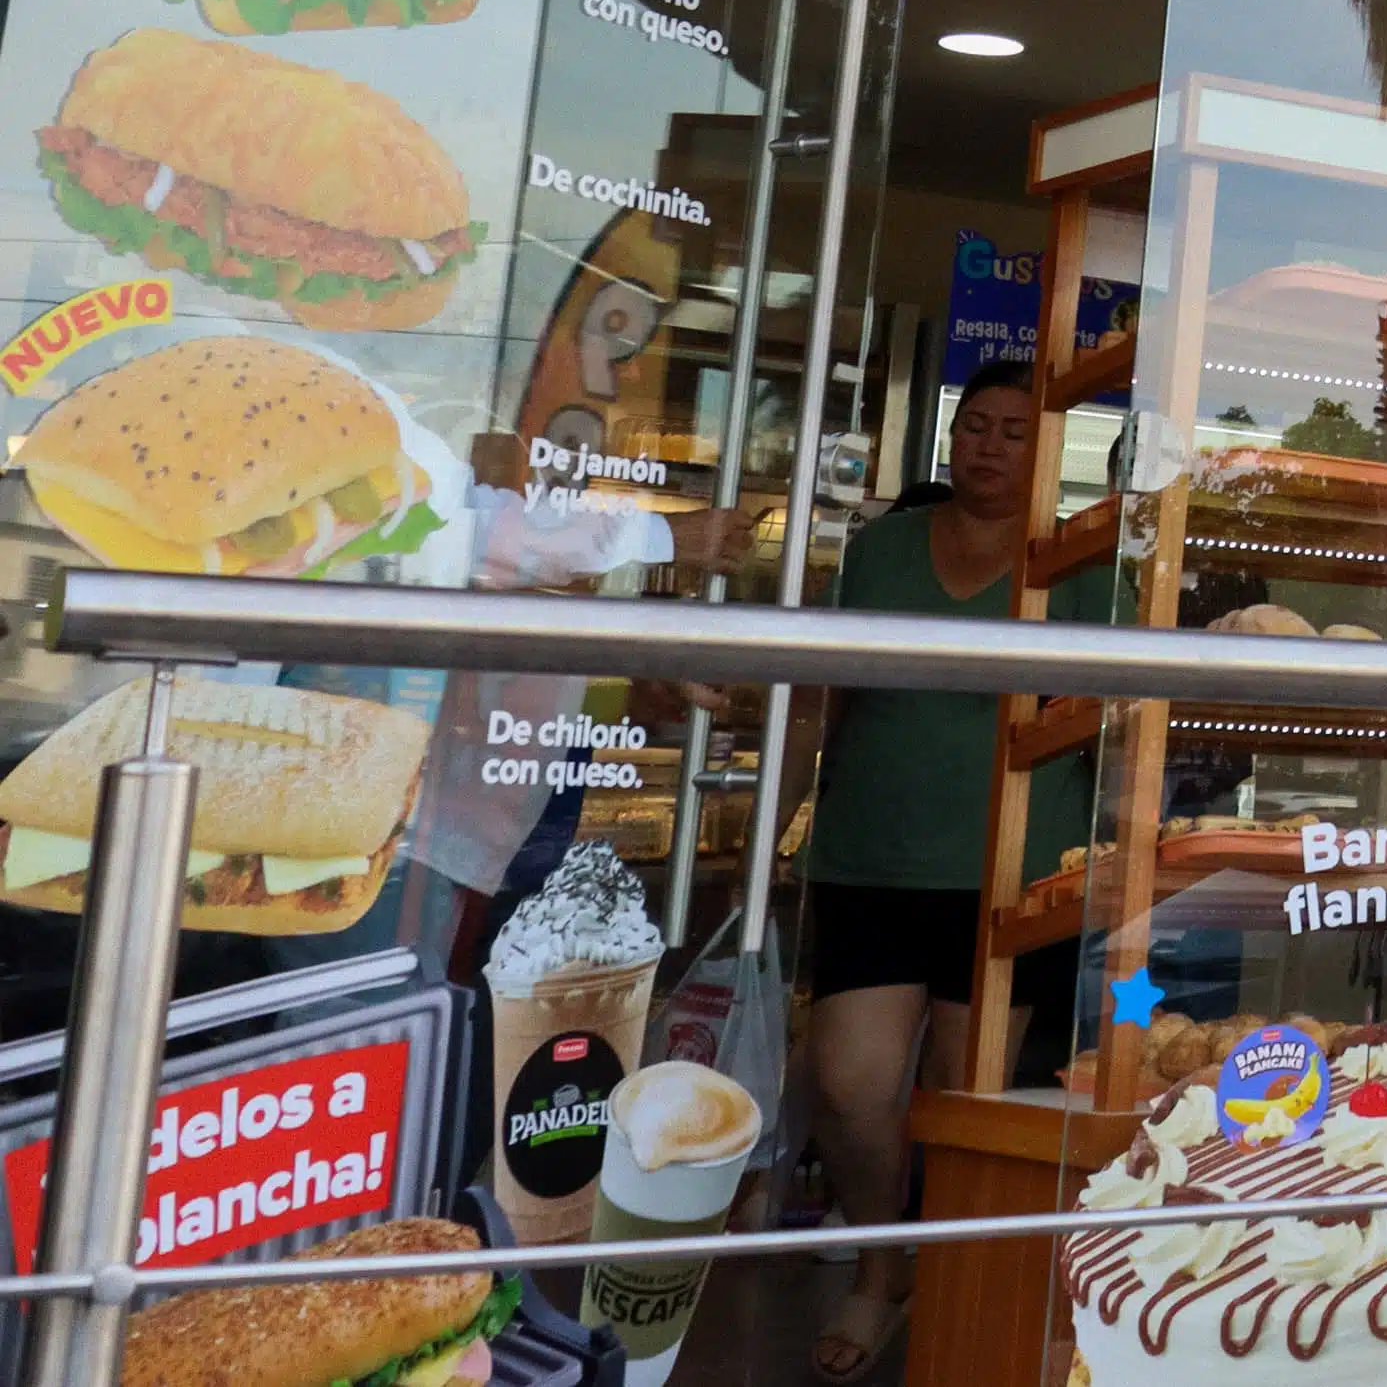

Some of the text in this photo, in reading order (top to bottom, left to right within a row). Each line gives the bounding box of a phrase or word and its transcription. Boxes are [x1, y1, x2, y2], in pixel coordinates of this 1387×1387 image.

[640, 8, 729, 56] queso.
[530, 154, 712, 226] De cochinita.
[2, 282, 170, 382] NUEVO
[529, 437, 668, 485] De jamón
[524, 482, 545, 514] y
[488, 710, 646, 750] De chilorio
[482, 755, 644, 791] con queso.
[1235, 1043, 1305, 1068] BANANA
[1239, 1057, 1304, 1079] FLANCAKE
[328, 1072, 366, 1118] a
[508, 1099, 612, 1145] PANADEL
